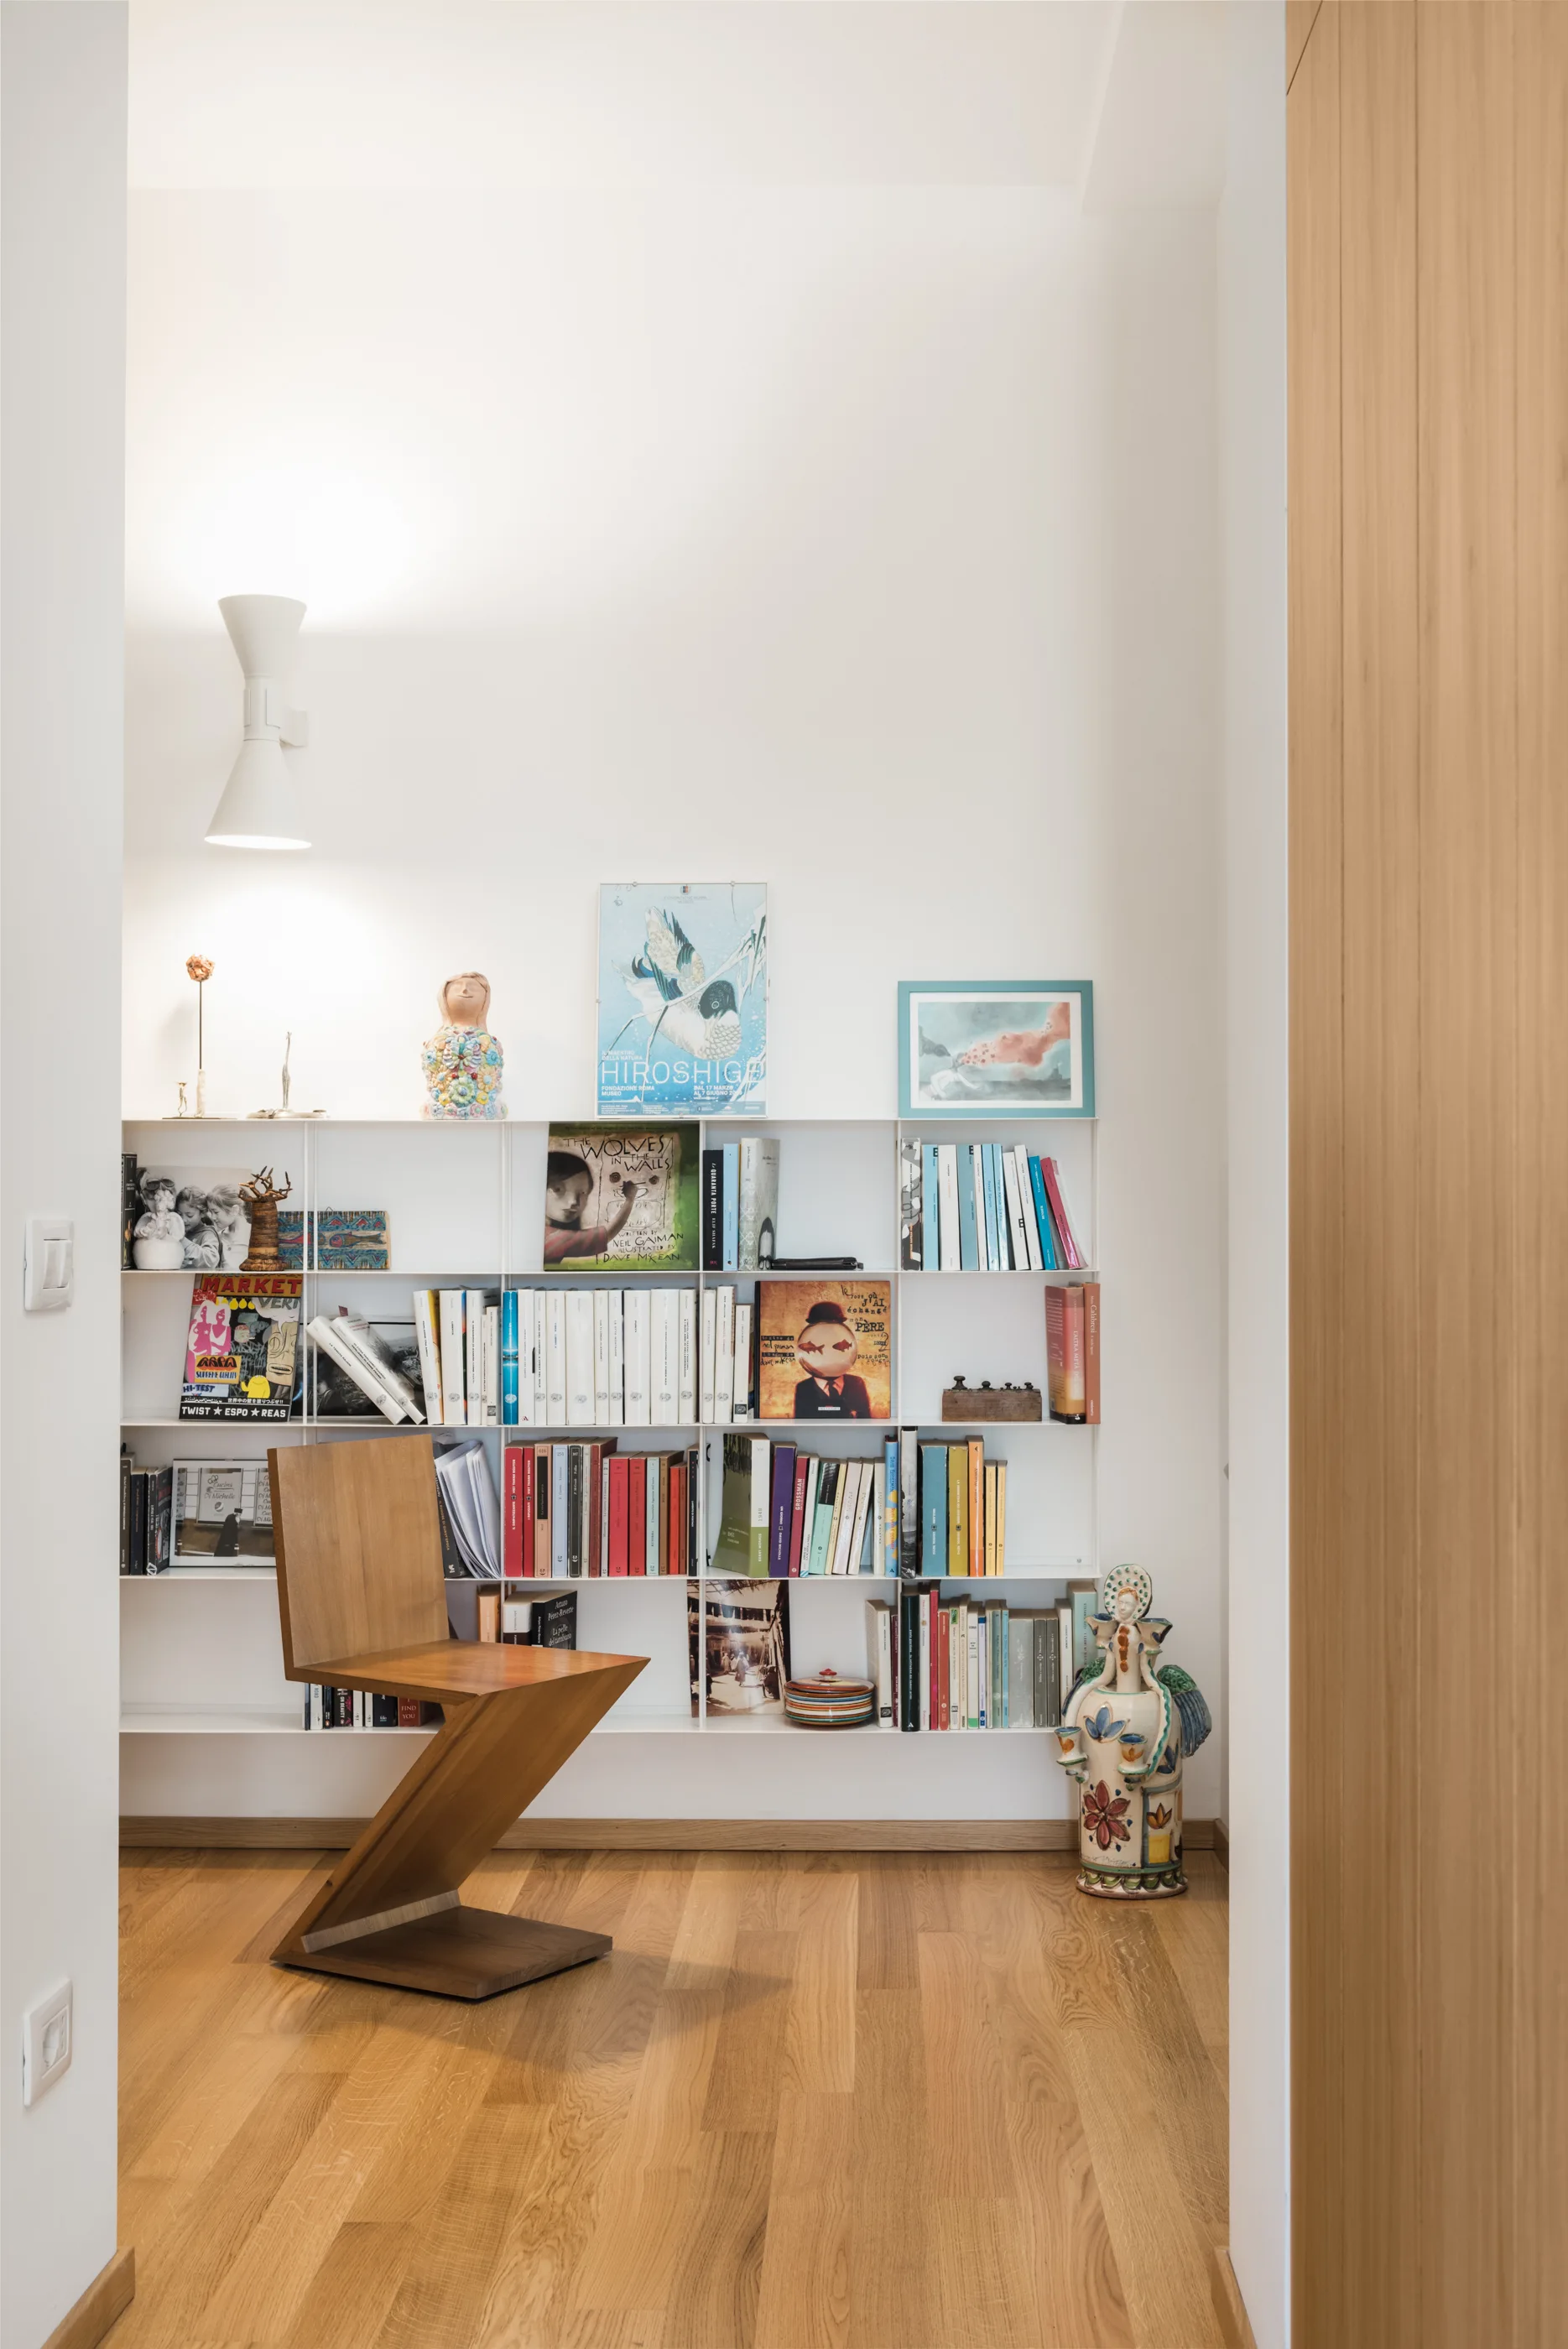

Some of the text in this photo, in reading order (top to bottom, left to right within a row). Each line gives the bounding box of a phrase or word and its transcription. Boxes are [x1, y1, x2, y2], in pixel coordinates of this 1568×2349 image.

[602, 1060, 763, 1084] HIROSHIGE
[563, 1137, 591, 1147] THE
[581, 1135, 664, 1159] WOLVES
[624, 1158, 669, 1172] WALLS
[613, 1233, 684, 1247] NEIL GAIMAN
[618, 1245, 664, 1253] ILLUSTRATED
[603, 1253, 630, 1263] DAVE
[201, 1278, 302, 1294] MARKET
[847, 1306, 888, 1315] échangé
[855, 1320, 885, 1333] PÈRE
[182, 1384, 216, 1393] HI-TEST
[181, 1406, 286, 1418] TWIST ESPO REAS
[794, 1478, 803, 1511] GROSSMAN
[555, 1599, 568, 1610] Arturo
[548, 1606, 574, 1622] Pérez-Reverte
[558, 1623, 569, 1636] pelle
[555, 1633, 572, 1644] tamburo
